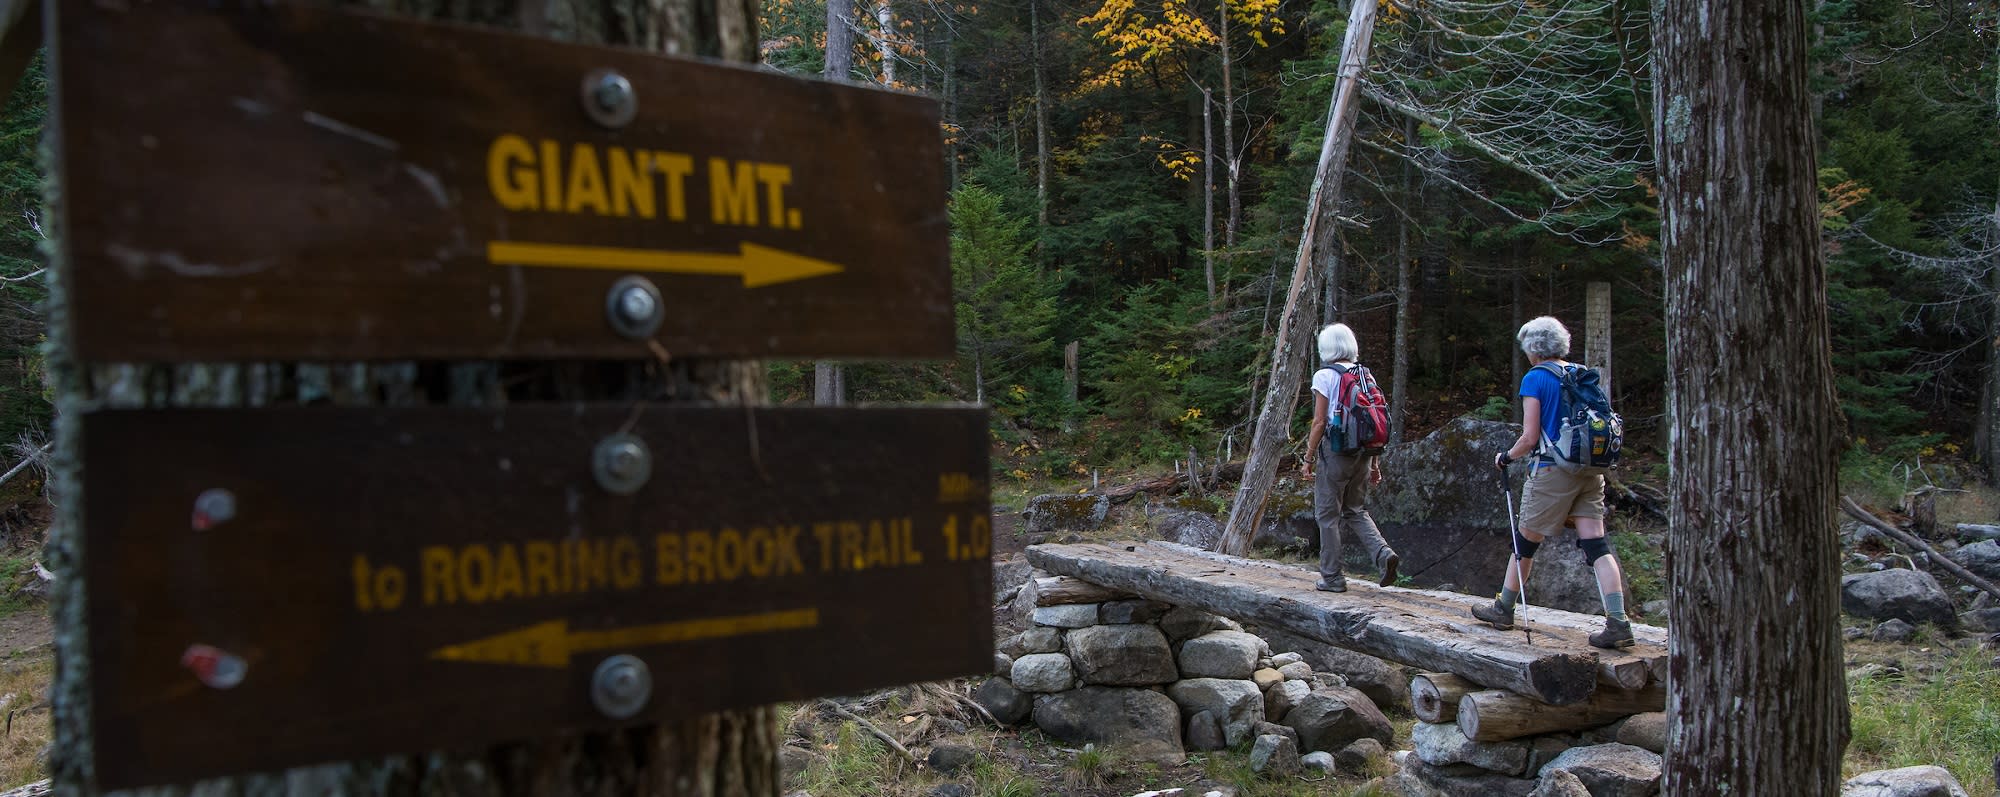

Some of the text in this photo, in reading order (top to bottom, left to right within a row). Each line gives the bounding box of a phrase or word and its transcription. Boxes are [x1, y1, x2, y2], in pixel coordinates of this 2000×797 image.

[487, 134, 802, 230] GIANT MT.
[353, 513, 991, 611] to ROARING BROOK TRAIL 1.0
